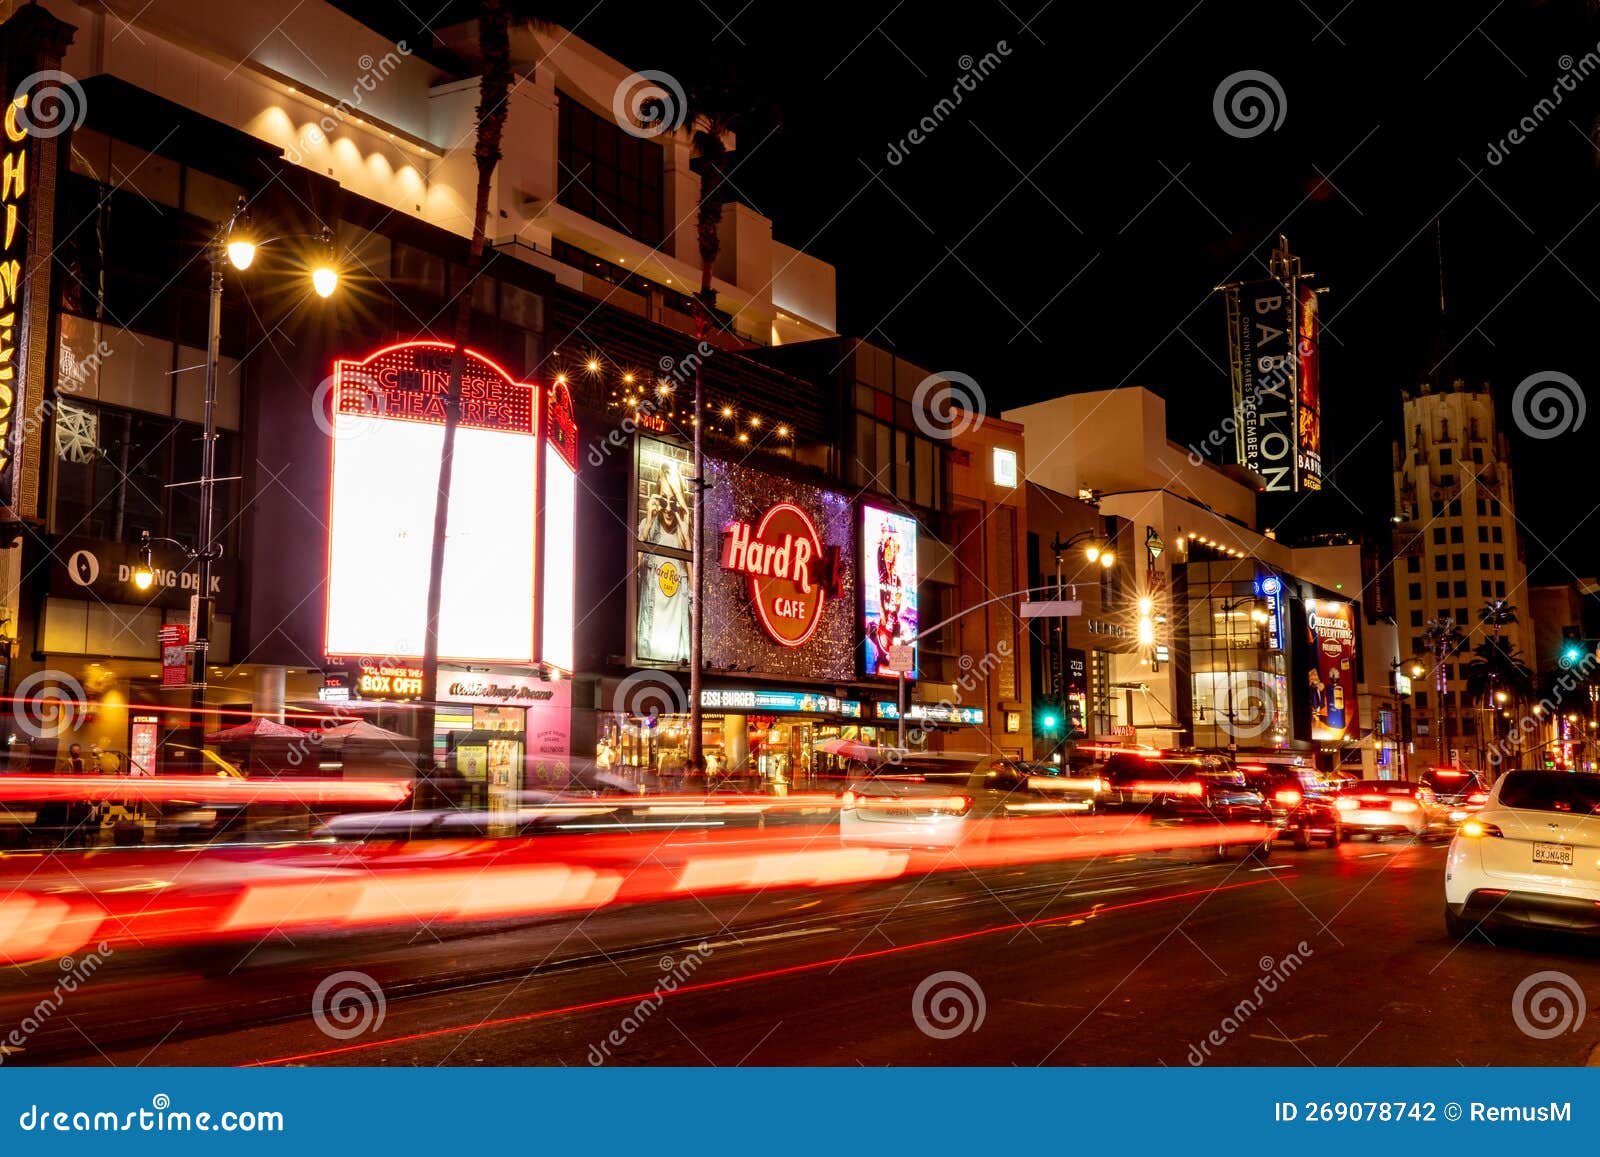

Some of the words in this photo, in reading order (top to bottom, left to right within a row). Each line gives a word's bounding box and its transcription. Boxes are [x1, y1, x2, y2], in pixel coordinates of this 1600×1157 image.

[1242, 317, 1250, 339] ONLY
[1243, 339, 1250, 351] IN
[1255, 295, 1291, 492] BABYLON
[366, 390, 513, 426] THEARES
[1246, 395, 1258, 460] DECEMBER
[1248, 462, 1260, 475] 2
[728, 521, 792, 579] Hard
[118, 564, 178, 588] DING
[181, 571, 221, 593] DEK
[774, 597, 807, 620] CAFE
[361, 675, 391, 693] BOX
[393, 677, 422, 695] OFFI
[700, 690, 756, 708] ESSI-BURGER
